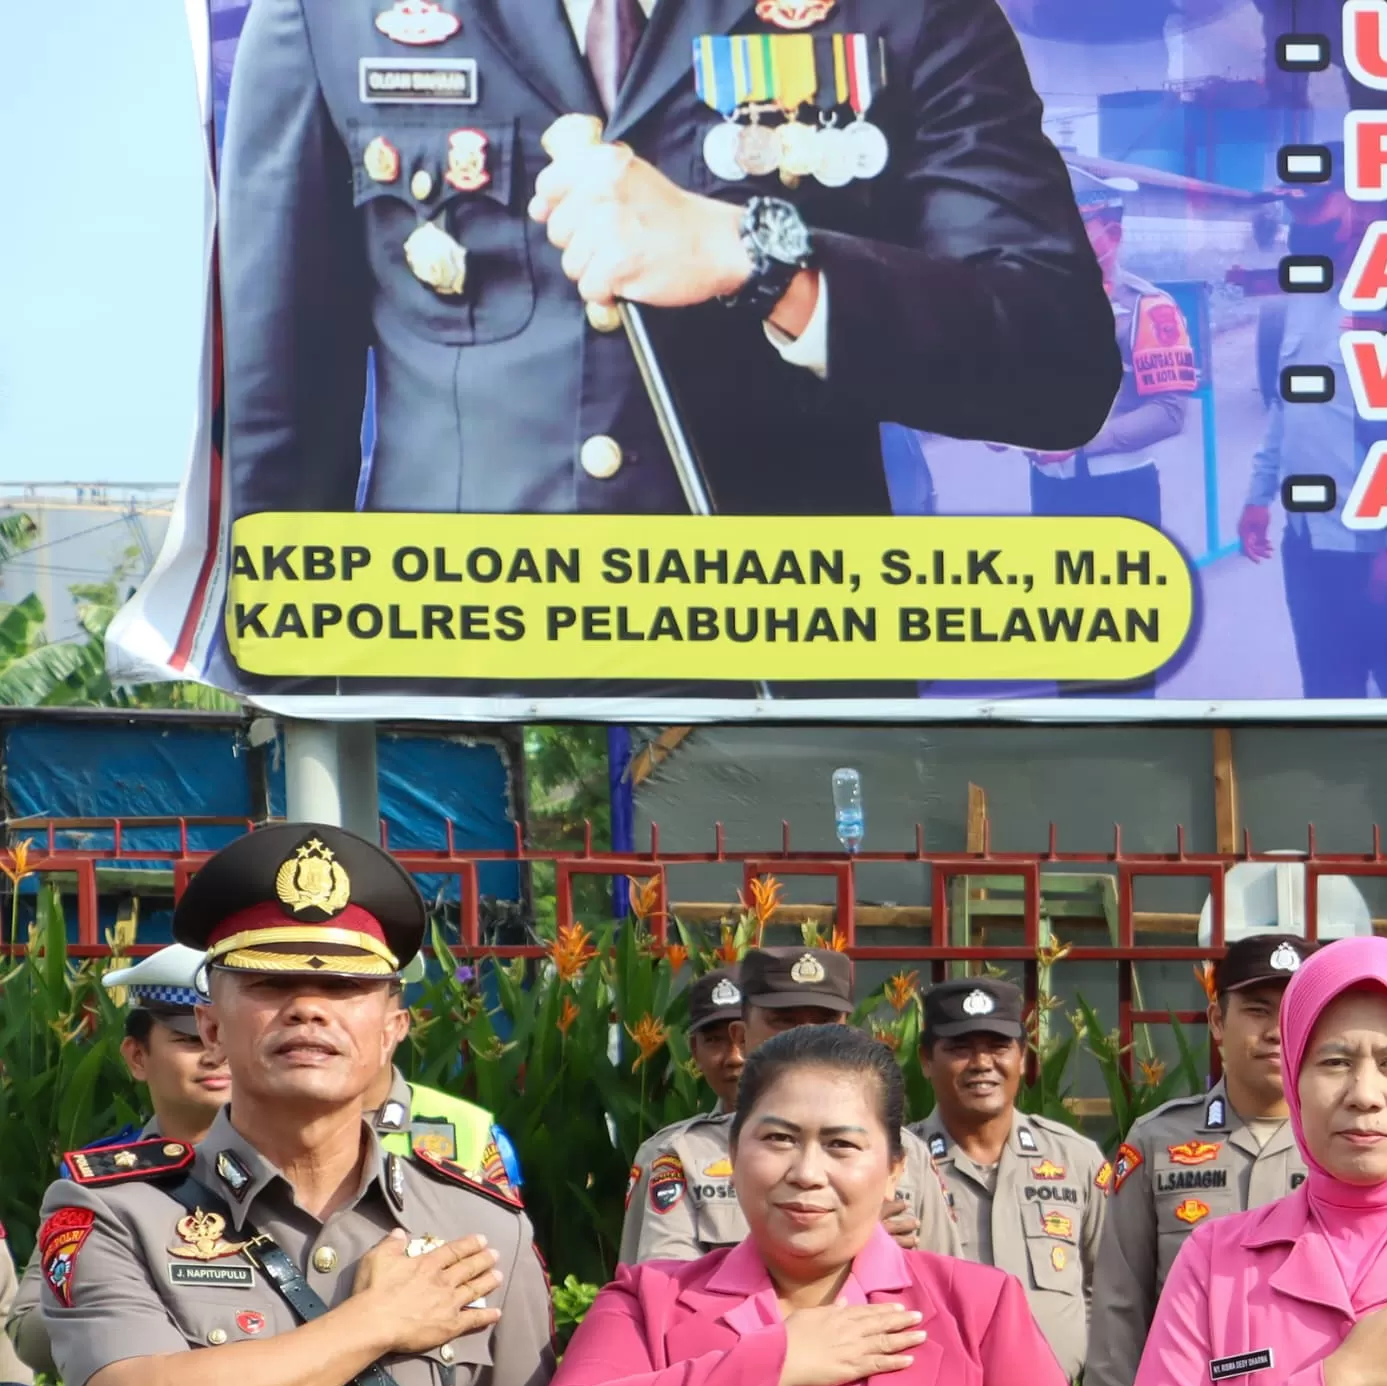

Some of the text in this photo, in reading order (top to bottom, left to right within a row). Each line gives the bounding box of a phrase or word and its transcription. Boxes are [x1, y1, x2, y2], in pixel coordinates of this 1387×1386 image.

[231, 545, 1168, 593] AKBP OLOAN SIAHAAN, S.I.K., M.H.
[235, 602, 1160, 643] KAPOLRES PELABUHAN BELAWAN
[1158, 1170, 1227, 1191] L.SARAGIH
[1024, 1186, 1077, 1203] POLRI
[176, 1269, 247, 1280] J. NAPITUPULU
